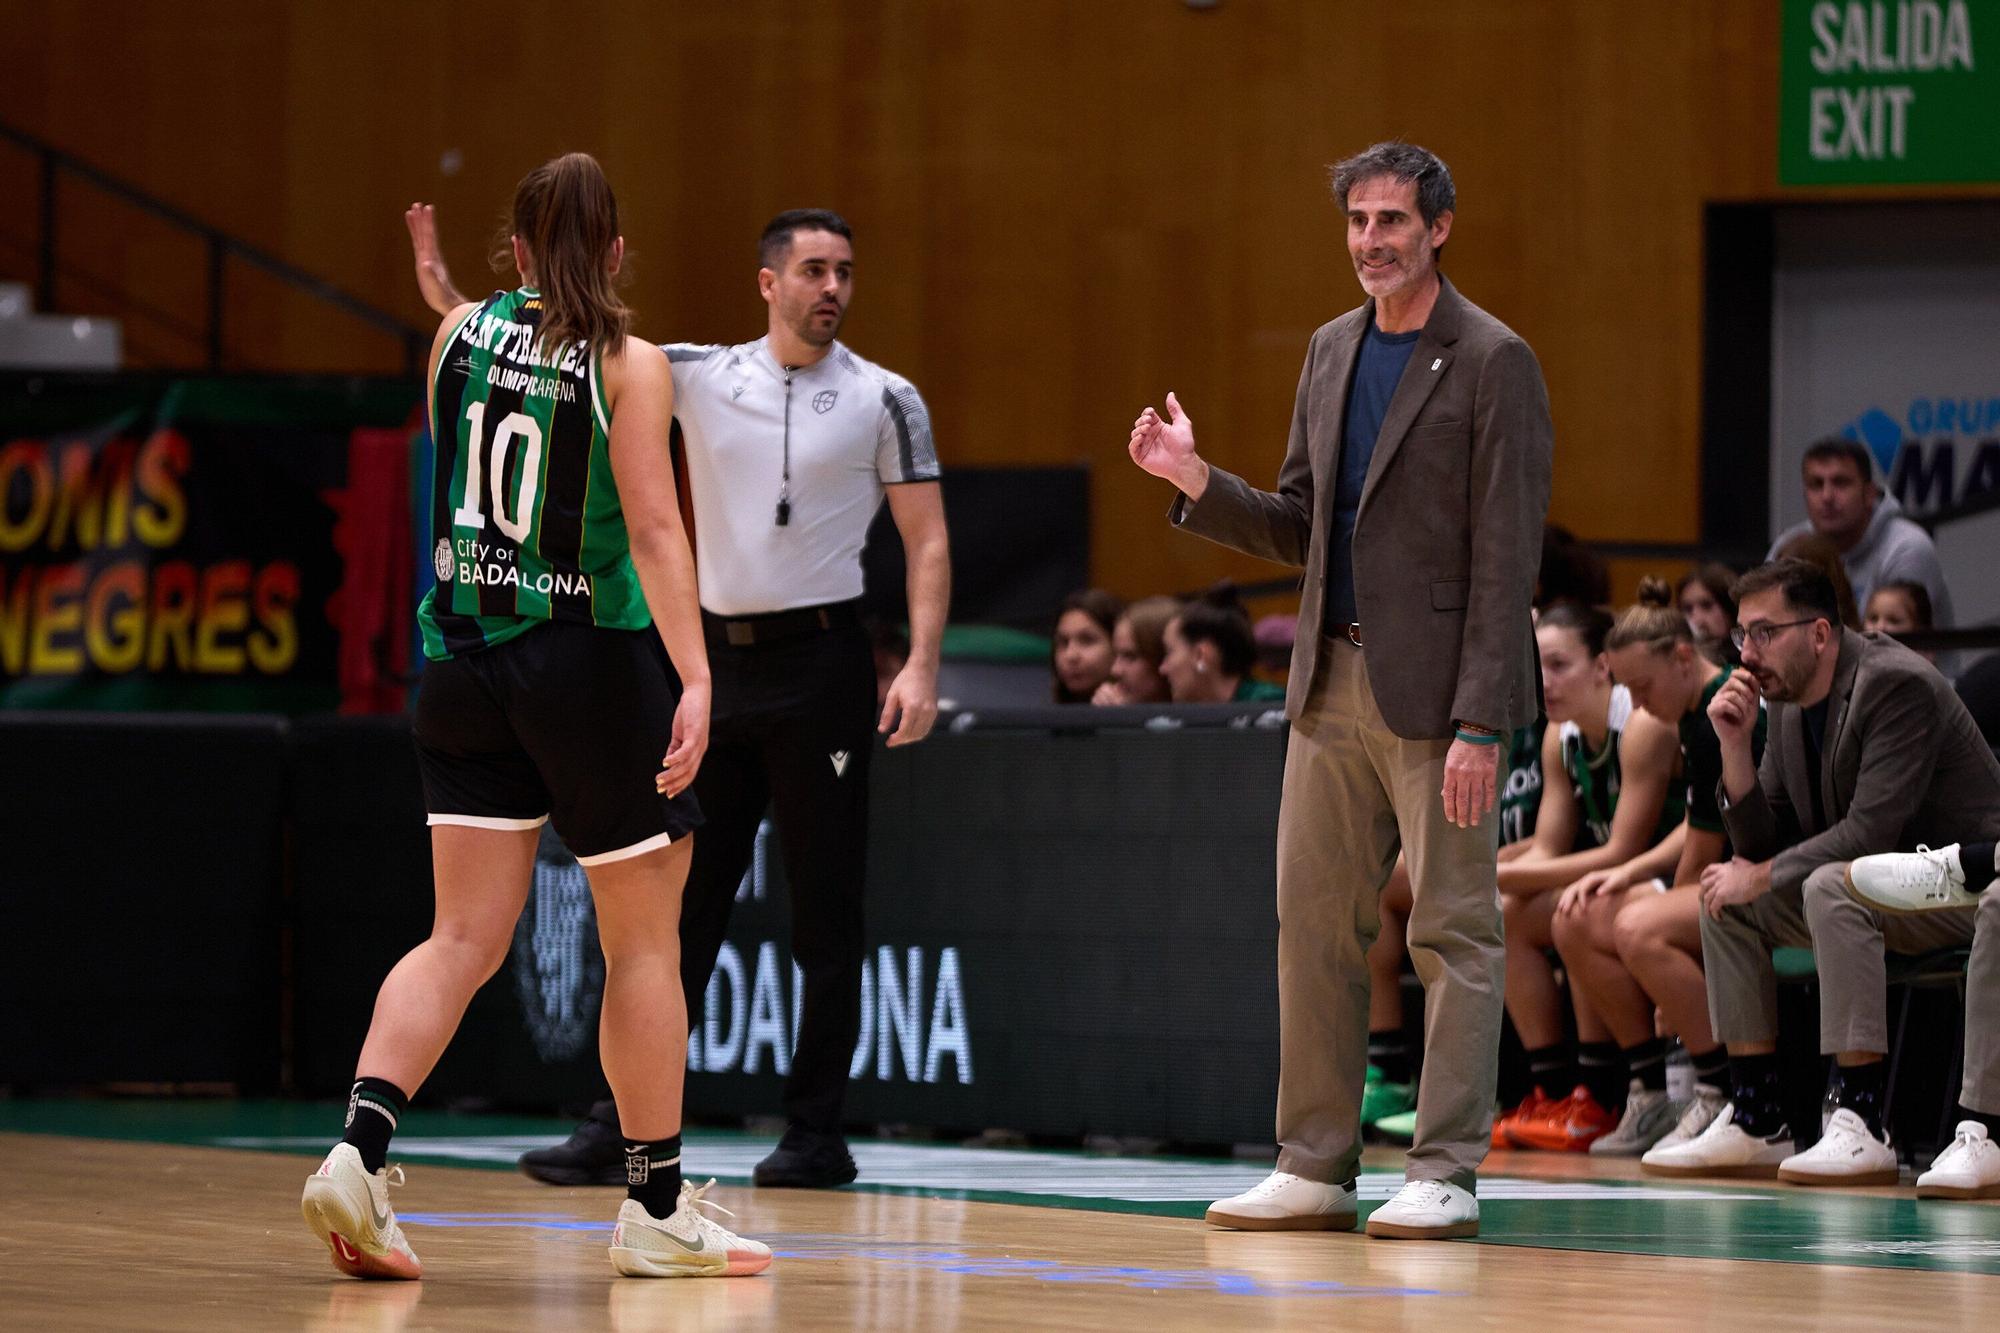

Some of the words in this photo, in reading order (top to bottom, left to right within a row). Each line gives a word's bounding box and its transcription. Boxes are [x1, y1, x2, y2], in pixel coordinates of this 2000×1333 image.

[1809, 0, 1974, 73] SALIDA
[1809, 86, 1915, 160] EXIT
[454, 400, 542, 544] 10
[457, 539, 490, 562] City
[495, 548, 515, 562] of
[459, 562, 591, 596] BADALONA
